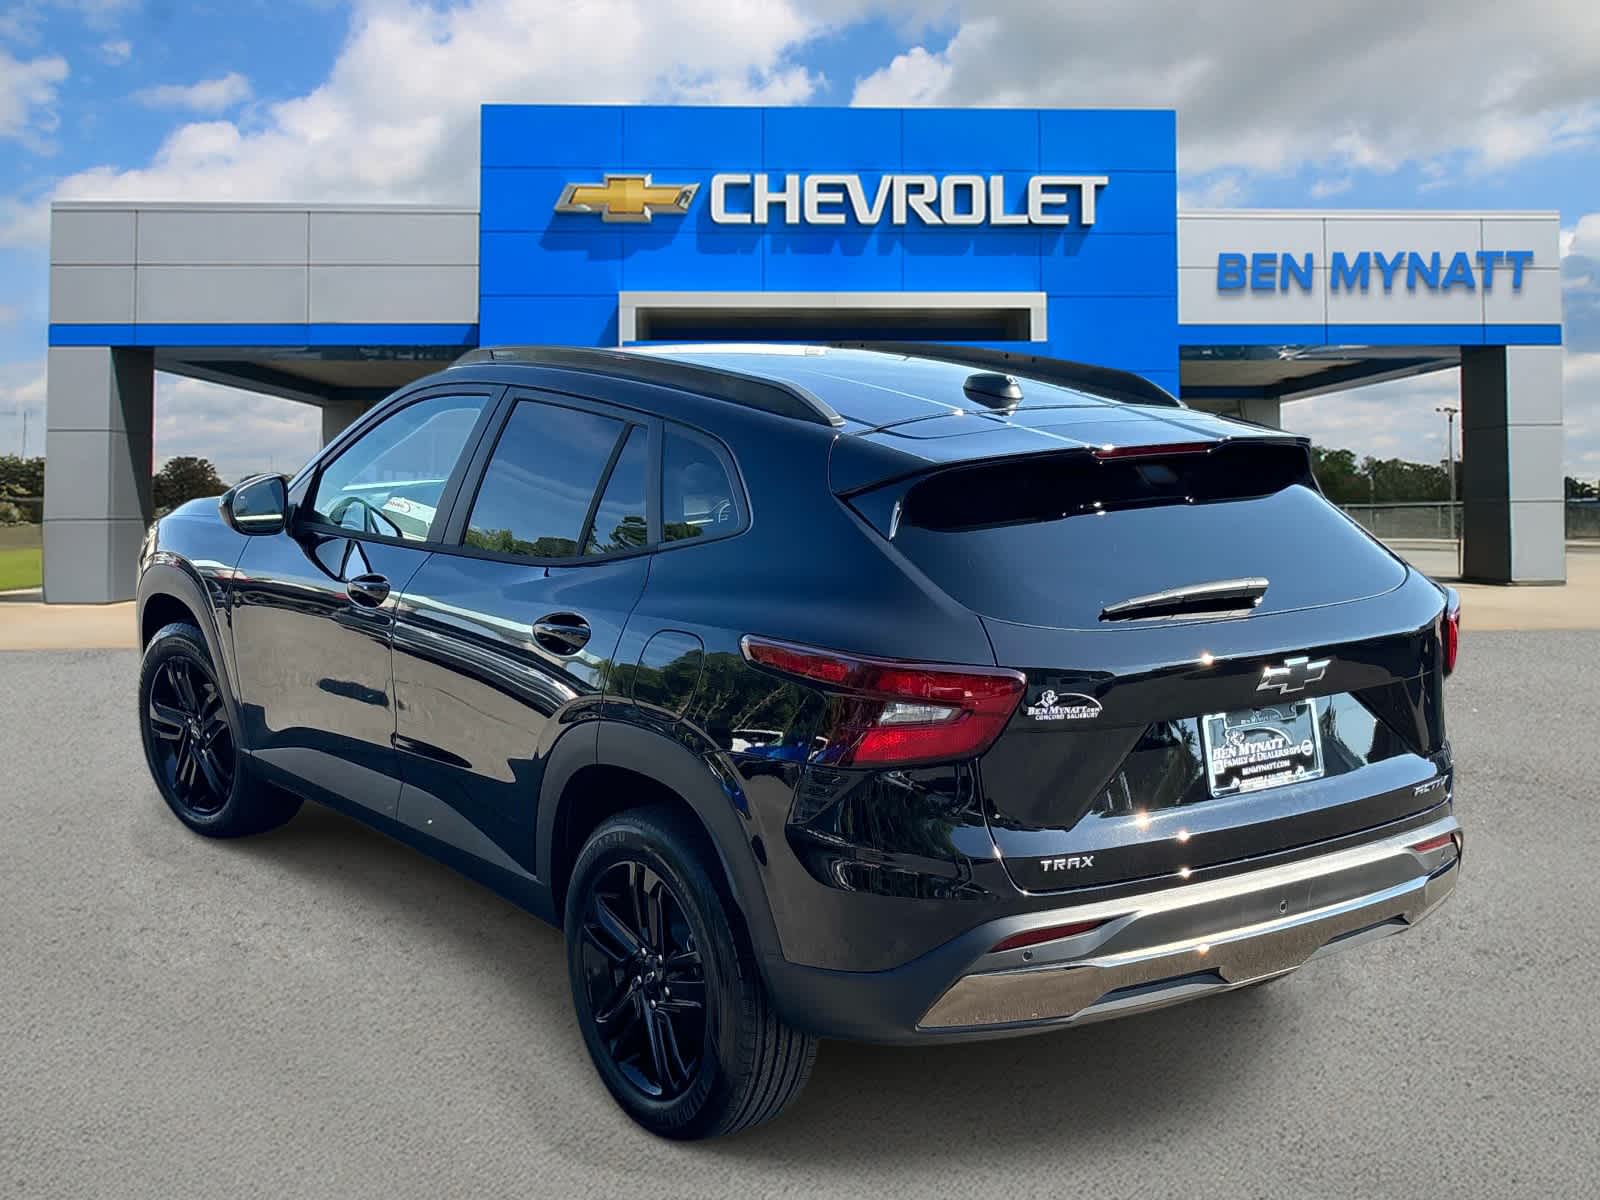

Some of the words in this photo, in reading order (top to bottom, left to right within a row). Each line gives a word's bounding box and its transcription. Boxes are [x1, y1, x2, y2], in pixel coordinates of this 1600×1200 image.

[710, 174, 1109, 226] CHEVROLET
[1217, 252, 1314, 290] BEN
[1330, 250, 1534, 290] MYNATT
[1213, 745, 1237, 761] BEN
[1239, 737, 1284, 756] MYNATT
[1040, 855, 1095, 872] TRAX
